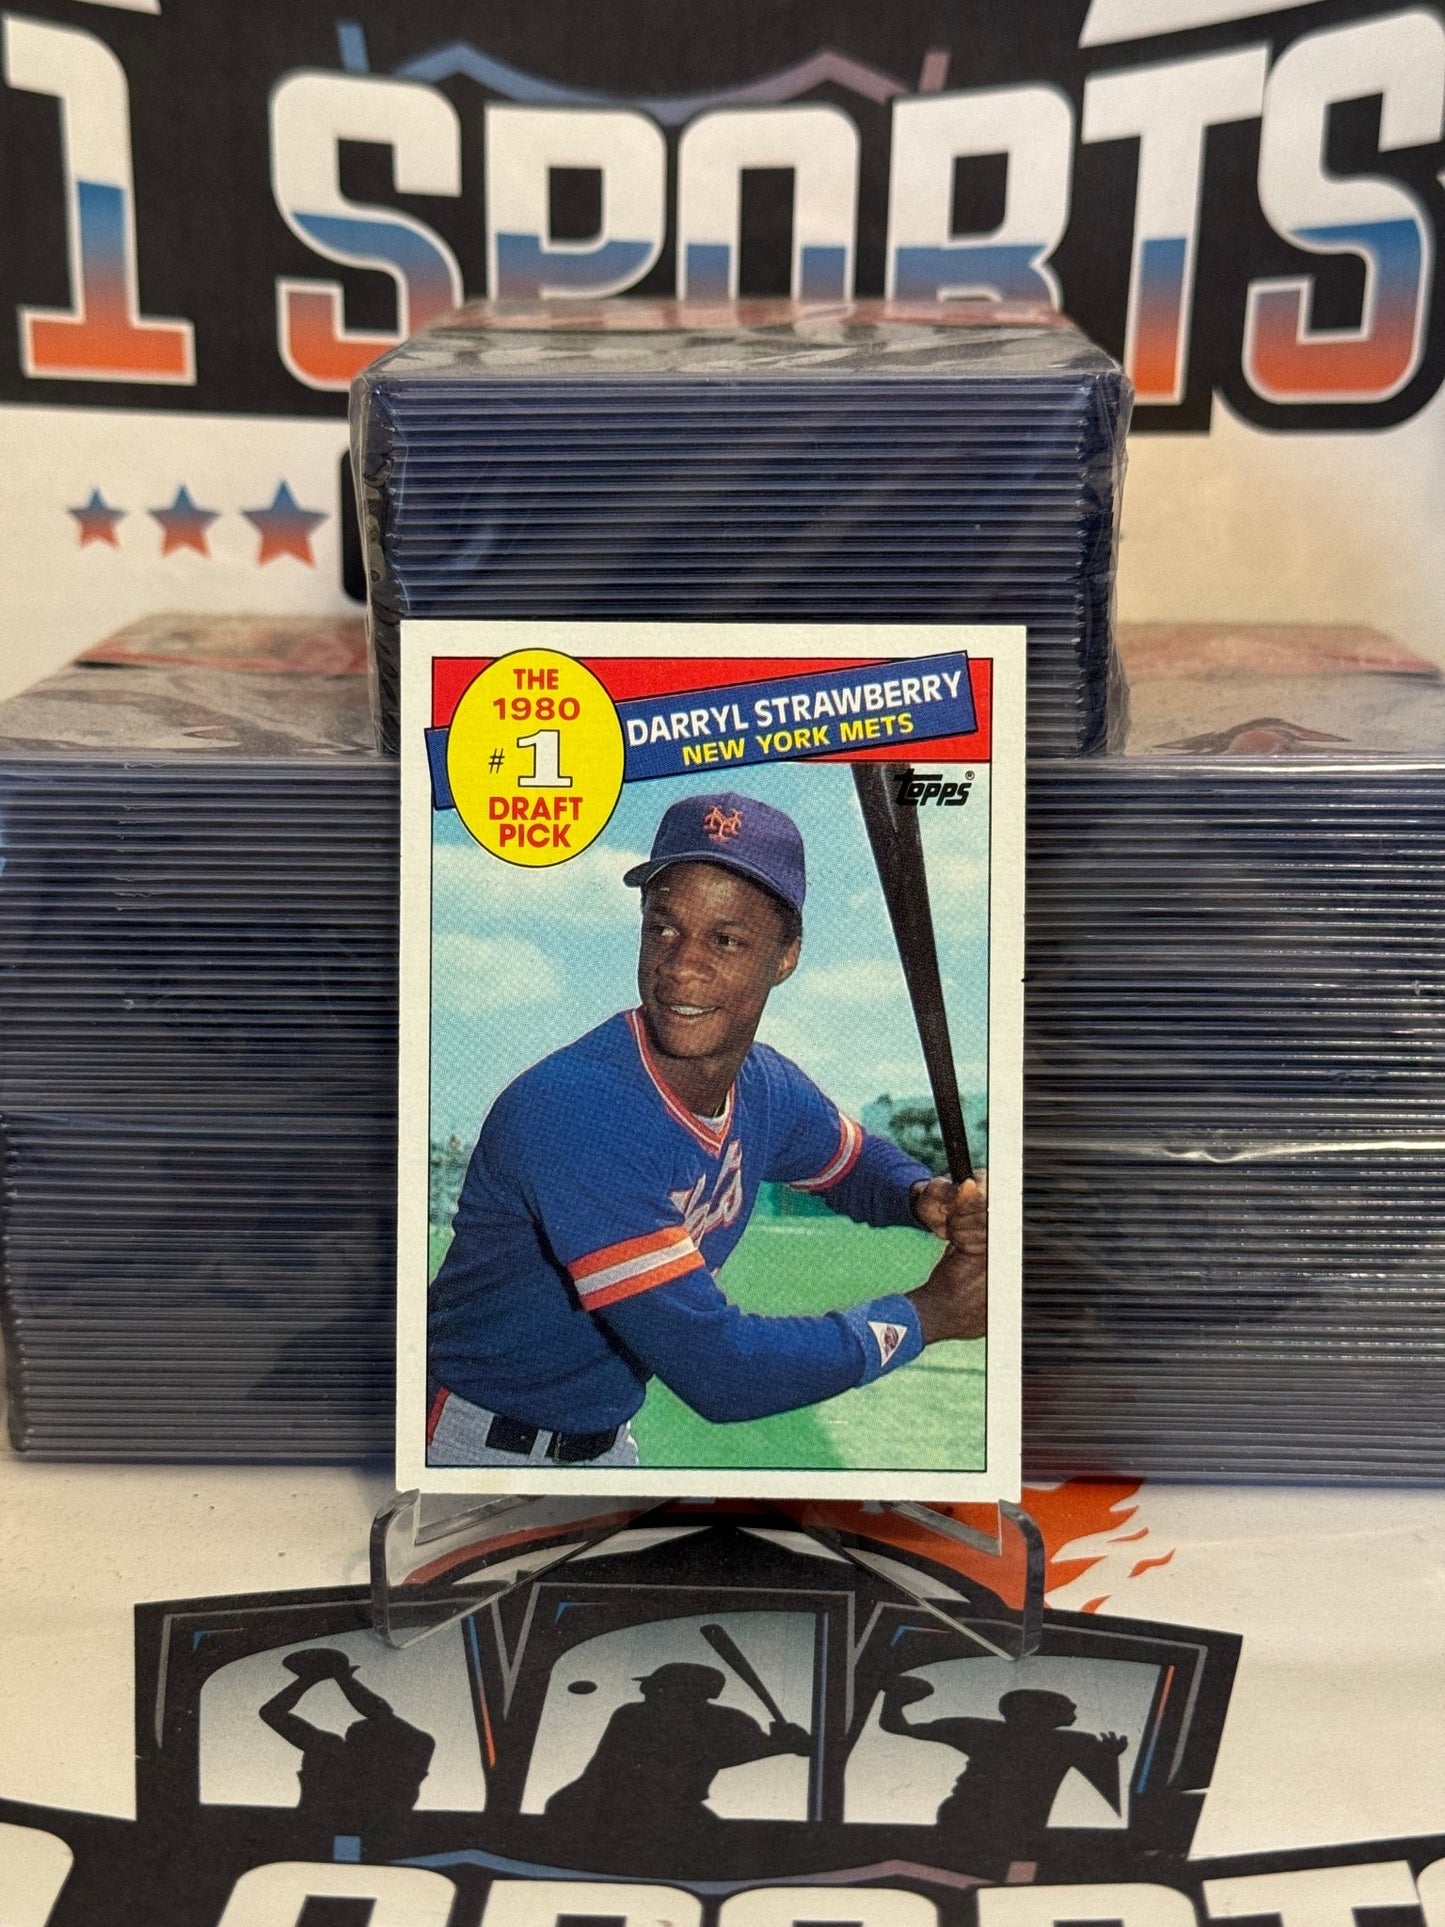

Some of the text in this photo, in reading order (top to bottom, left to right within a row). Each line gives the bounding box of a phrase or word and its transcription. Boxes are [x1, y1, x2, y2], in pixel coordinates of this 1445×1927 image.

[268, 8, 1443, 404] SPORTS
[512, 668, 559, 690] THE
[492, 697, 581, 721] 1980
[625, 670, 963, 747] DARRYL STRAWBERRY
[682, 712, 915, 766] NEW YORK METS
[488, 796, 584, 821] DRAFT
[499, 823, 572, 848] PICK
